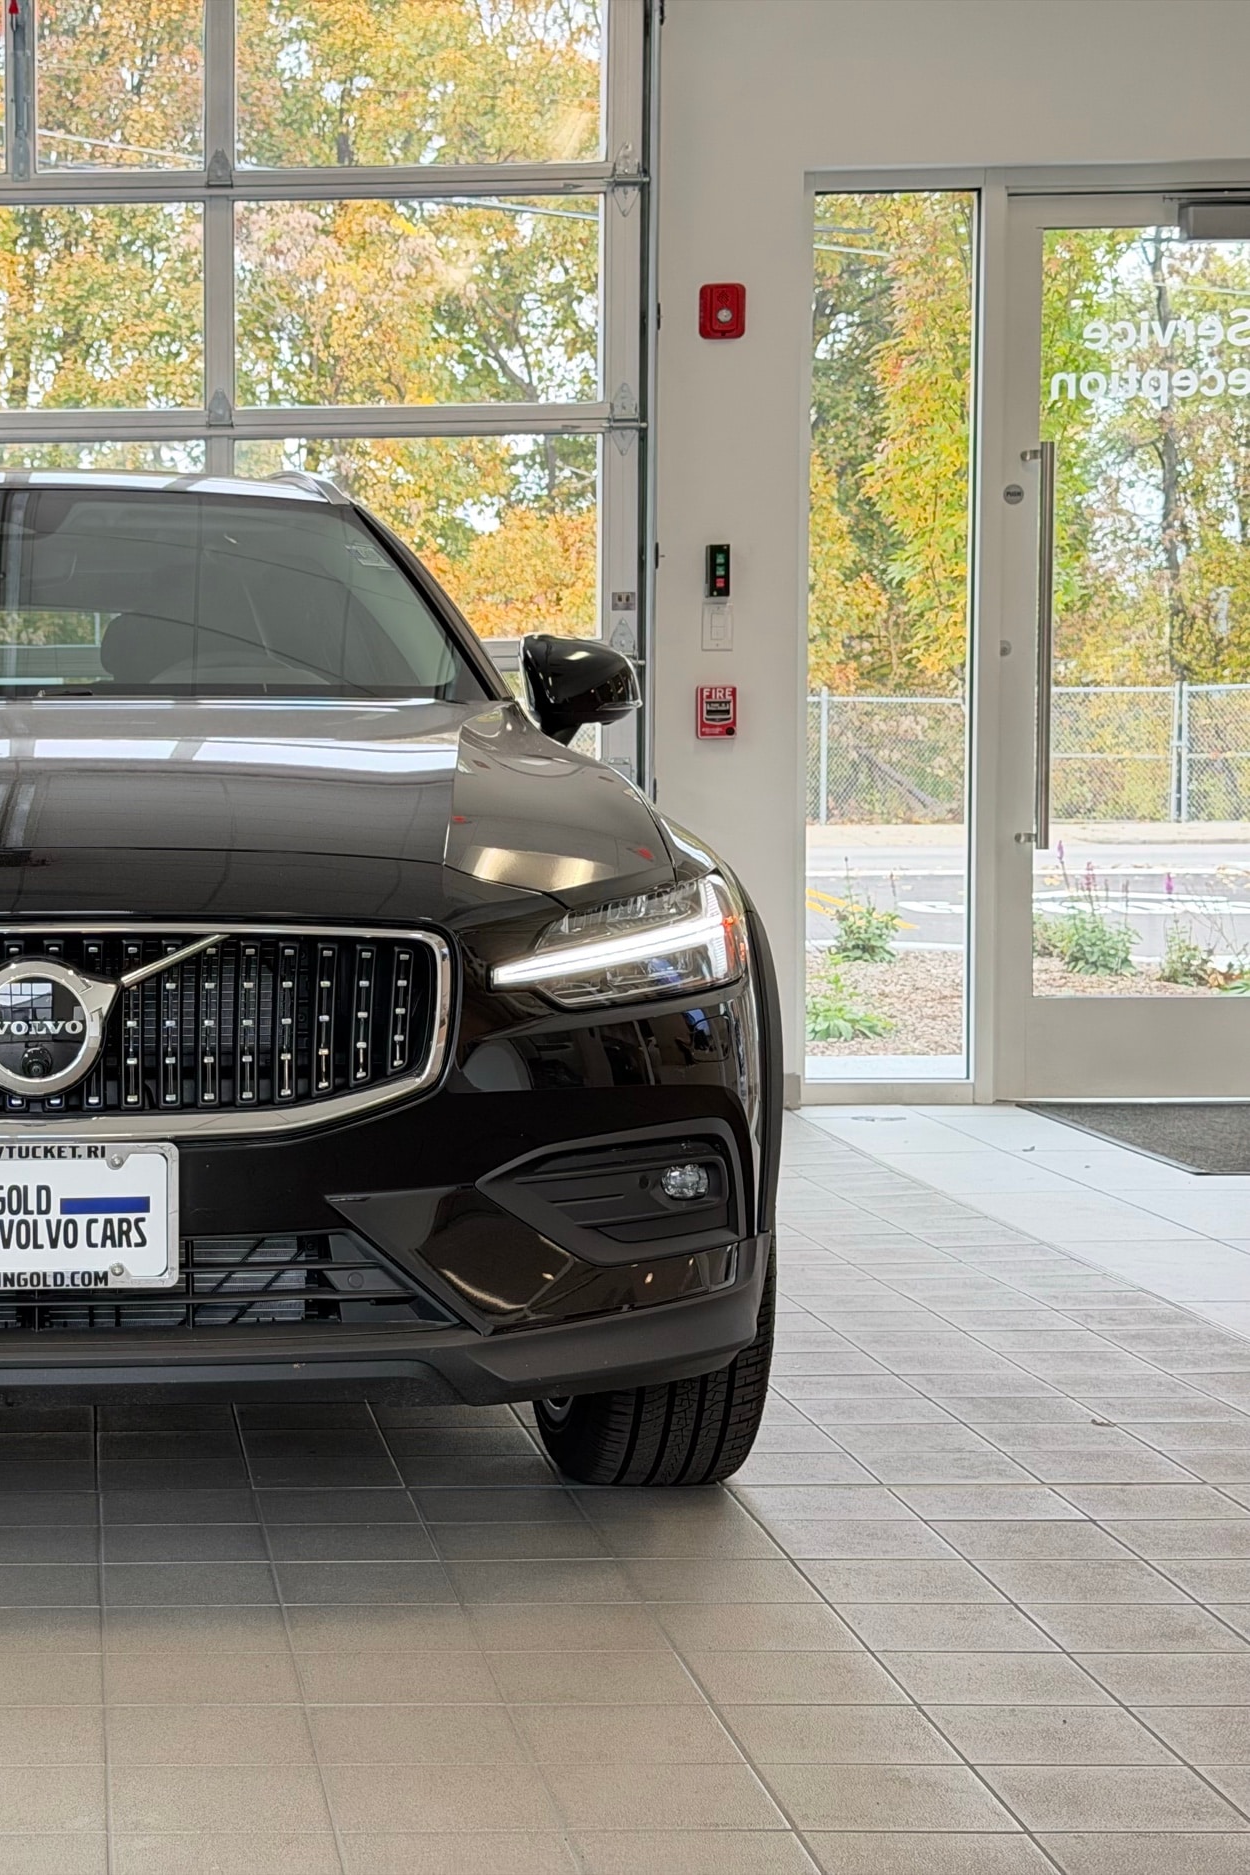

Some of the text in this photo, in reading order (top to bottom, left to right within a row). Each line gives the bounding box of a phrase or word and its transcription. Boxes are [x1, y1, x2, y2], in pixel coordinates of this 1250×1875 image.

[703, 688, 733, 699] FIRE
[87, 1145, 106, 1158] RI
[85, 1217, 148, 1248] CARS
